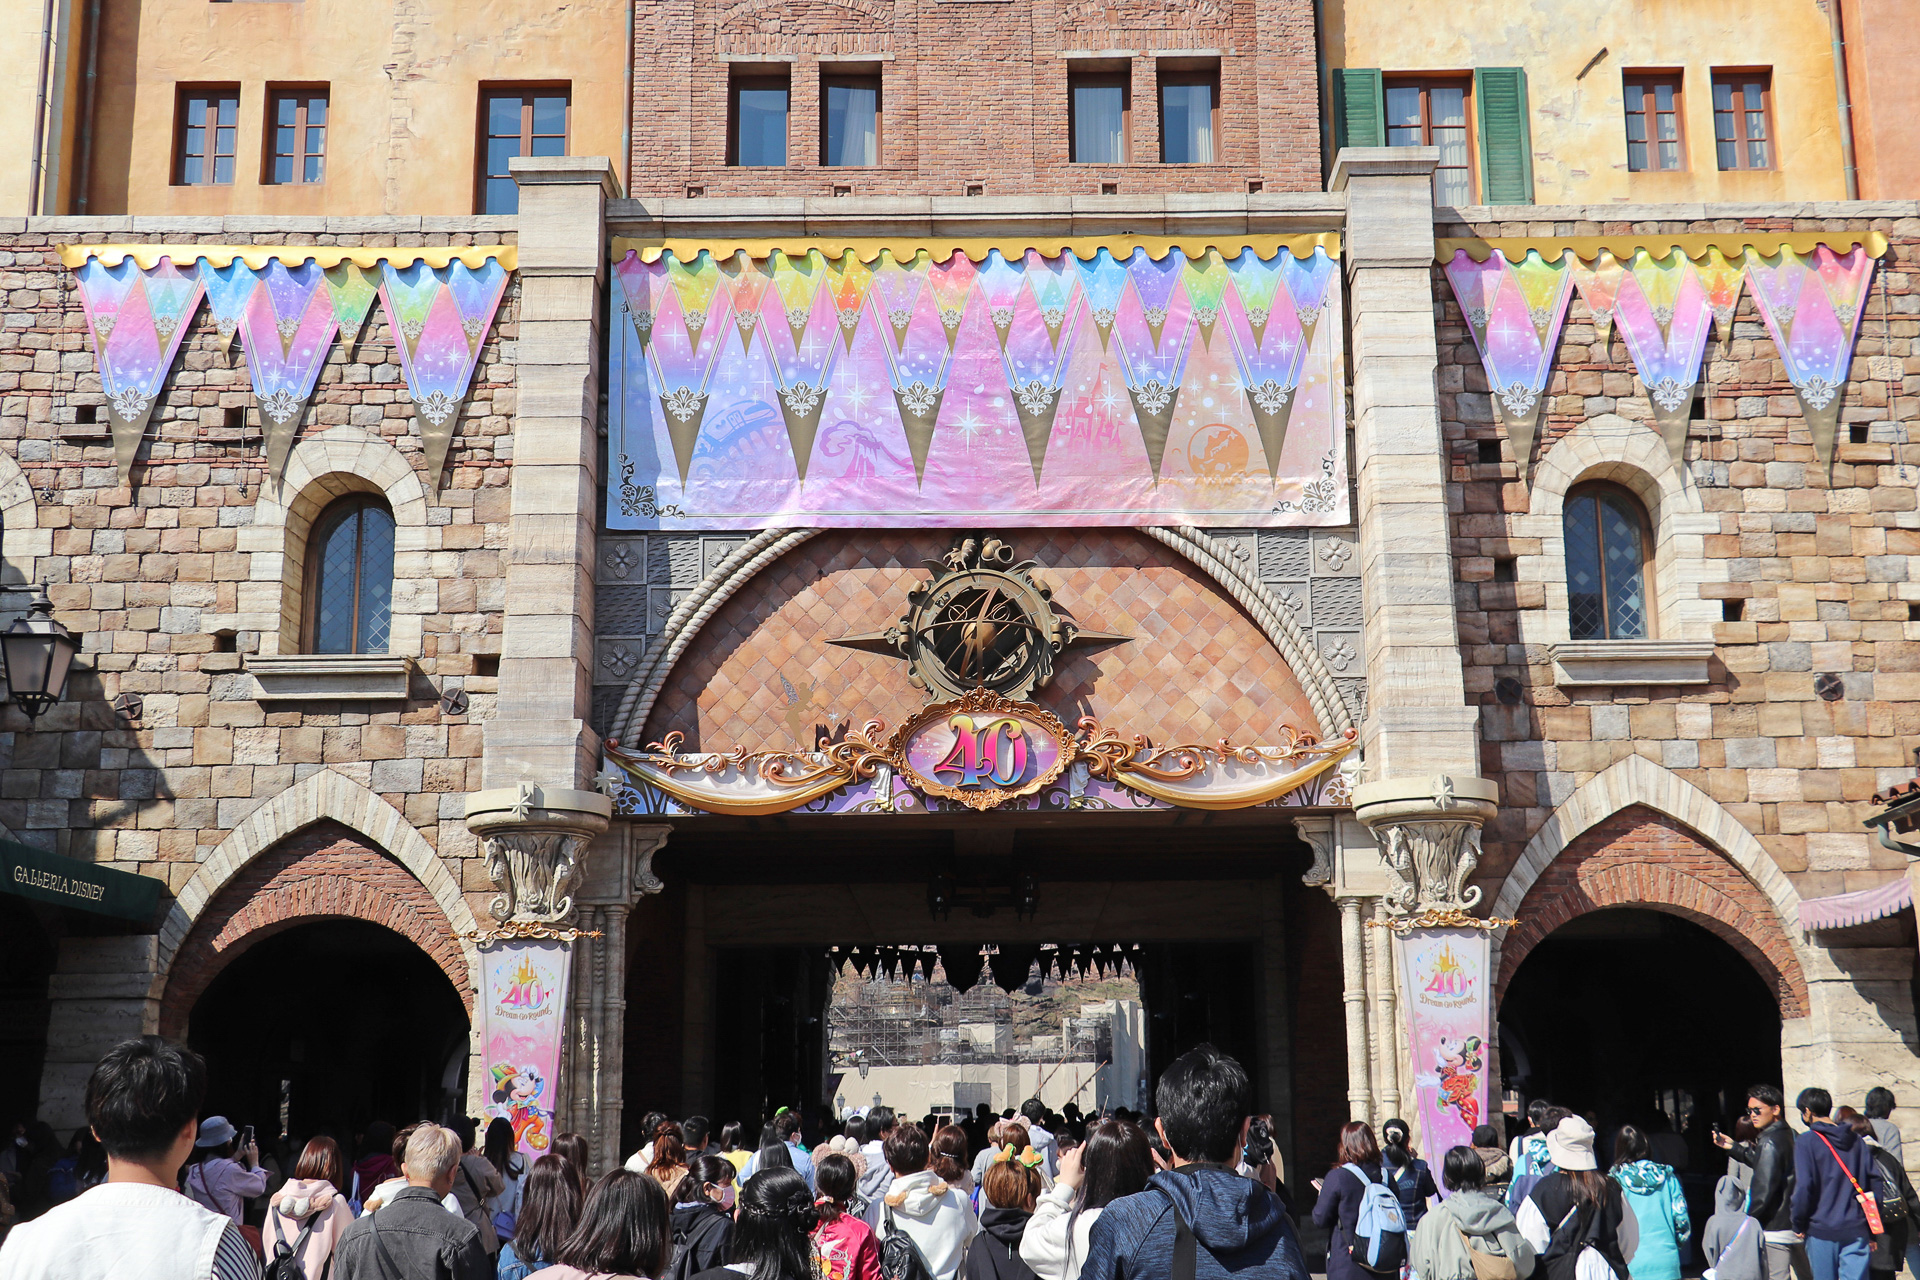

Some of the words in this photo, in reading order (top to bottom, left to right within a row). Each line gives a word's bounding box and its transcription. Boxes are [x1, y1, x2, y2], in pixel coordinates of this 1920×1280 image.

[933, 713, 1027, 787] 40
[14, 865, 69, 894] GALLERIA
[70, 879, 105, 901] DISNEY
[500, 975, 544, 1010] 40
[1424, 963, 1467, 998] 40
[494, 1004, 518, 1019] Dream
[528, 1003, 552, 1020] Round
[1419, 993, 1443, 1007] Dream
[1453, 991, 1477, 1009] Round
